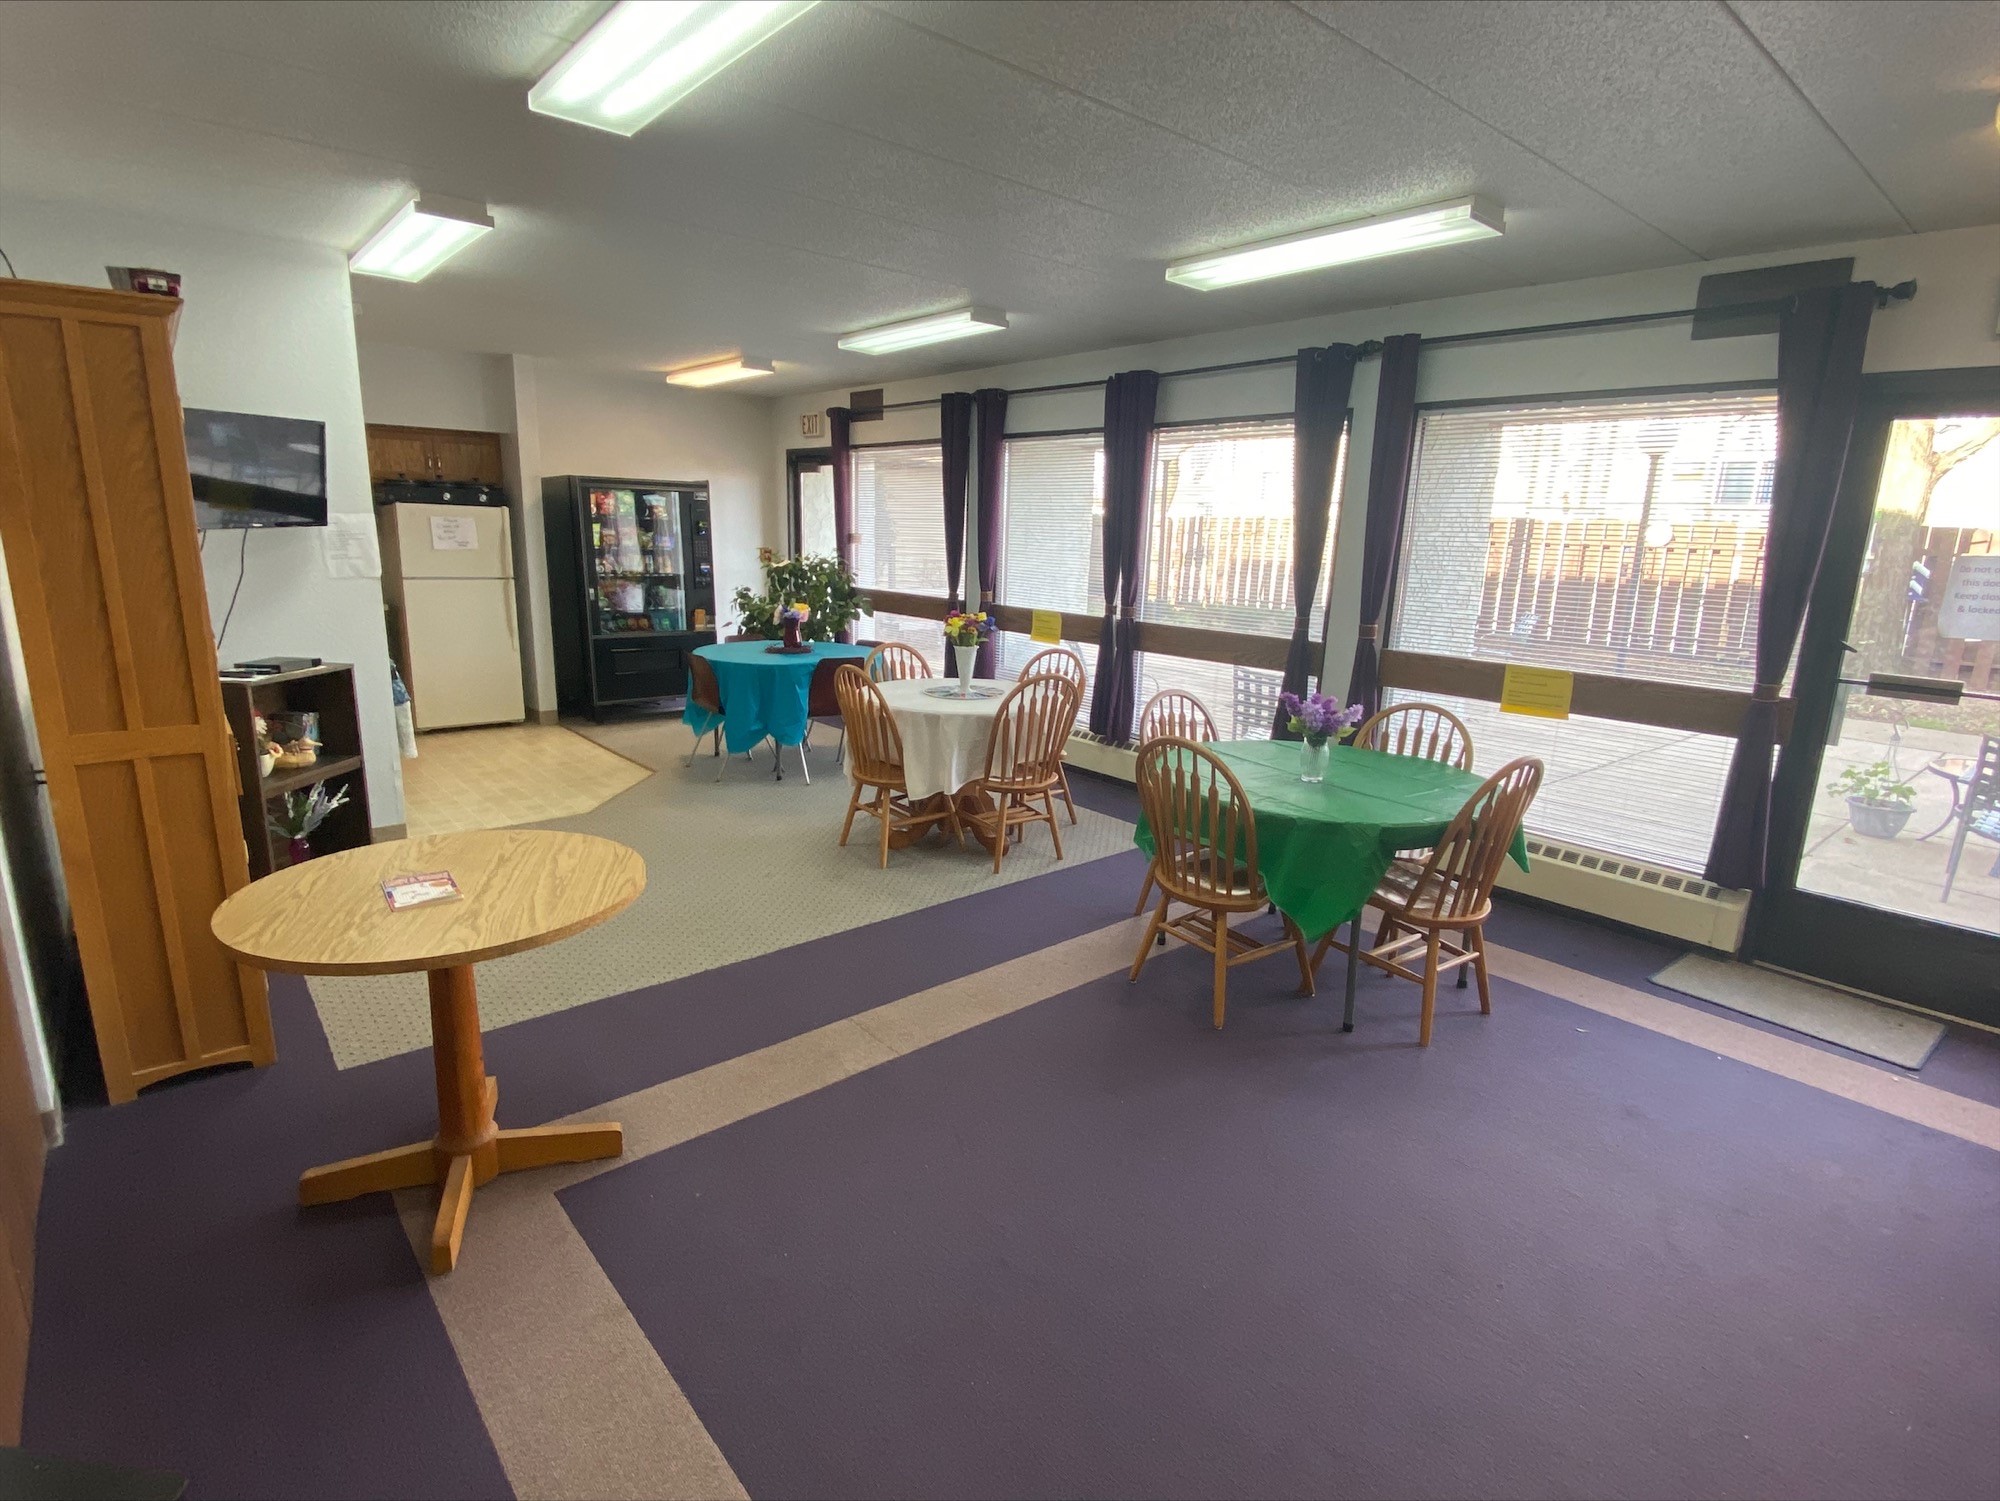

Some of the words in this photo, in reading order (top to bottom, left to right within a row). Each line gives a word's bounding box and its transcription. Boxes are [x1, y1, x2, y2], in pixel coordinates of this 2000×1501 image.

[802, 414, 818, 434] EXIT
[1962, 579, 1980, 587] this
[1957, 605, 1965, 613] &
